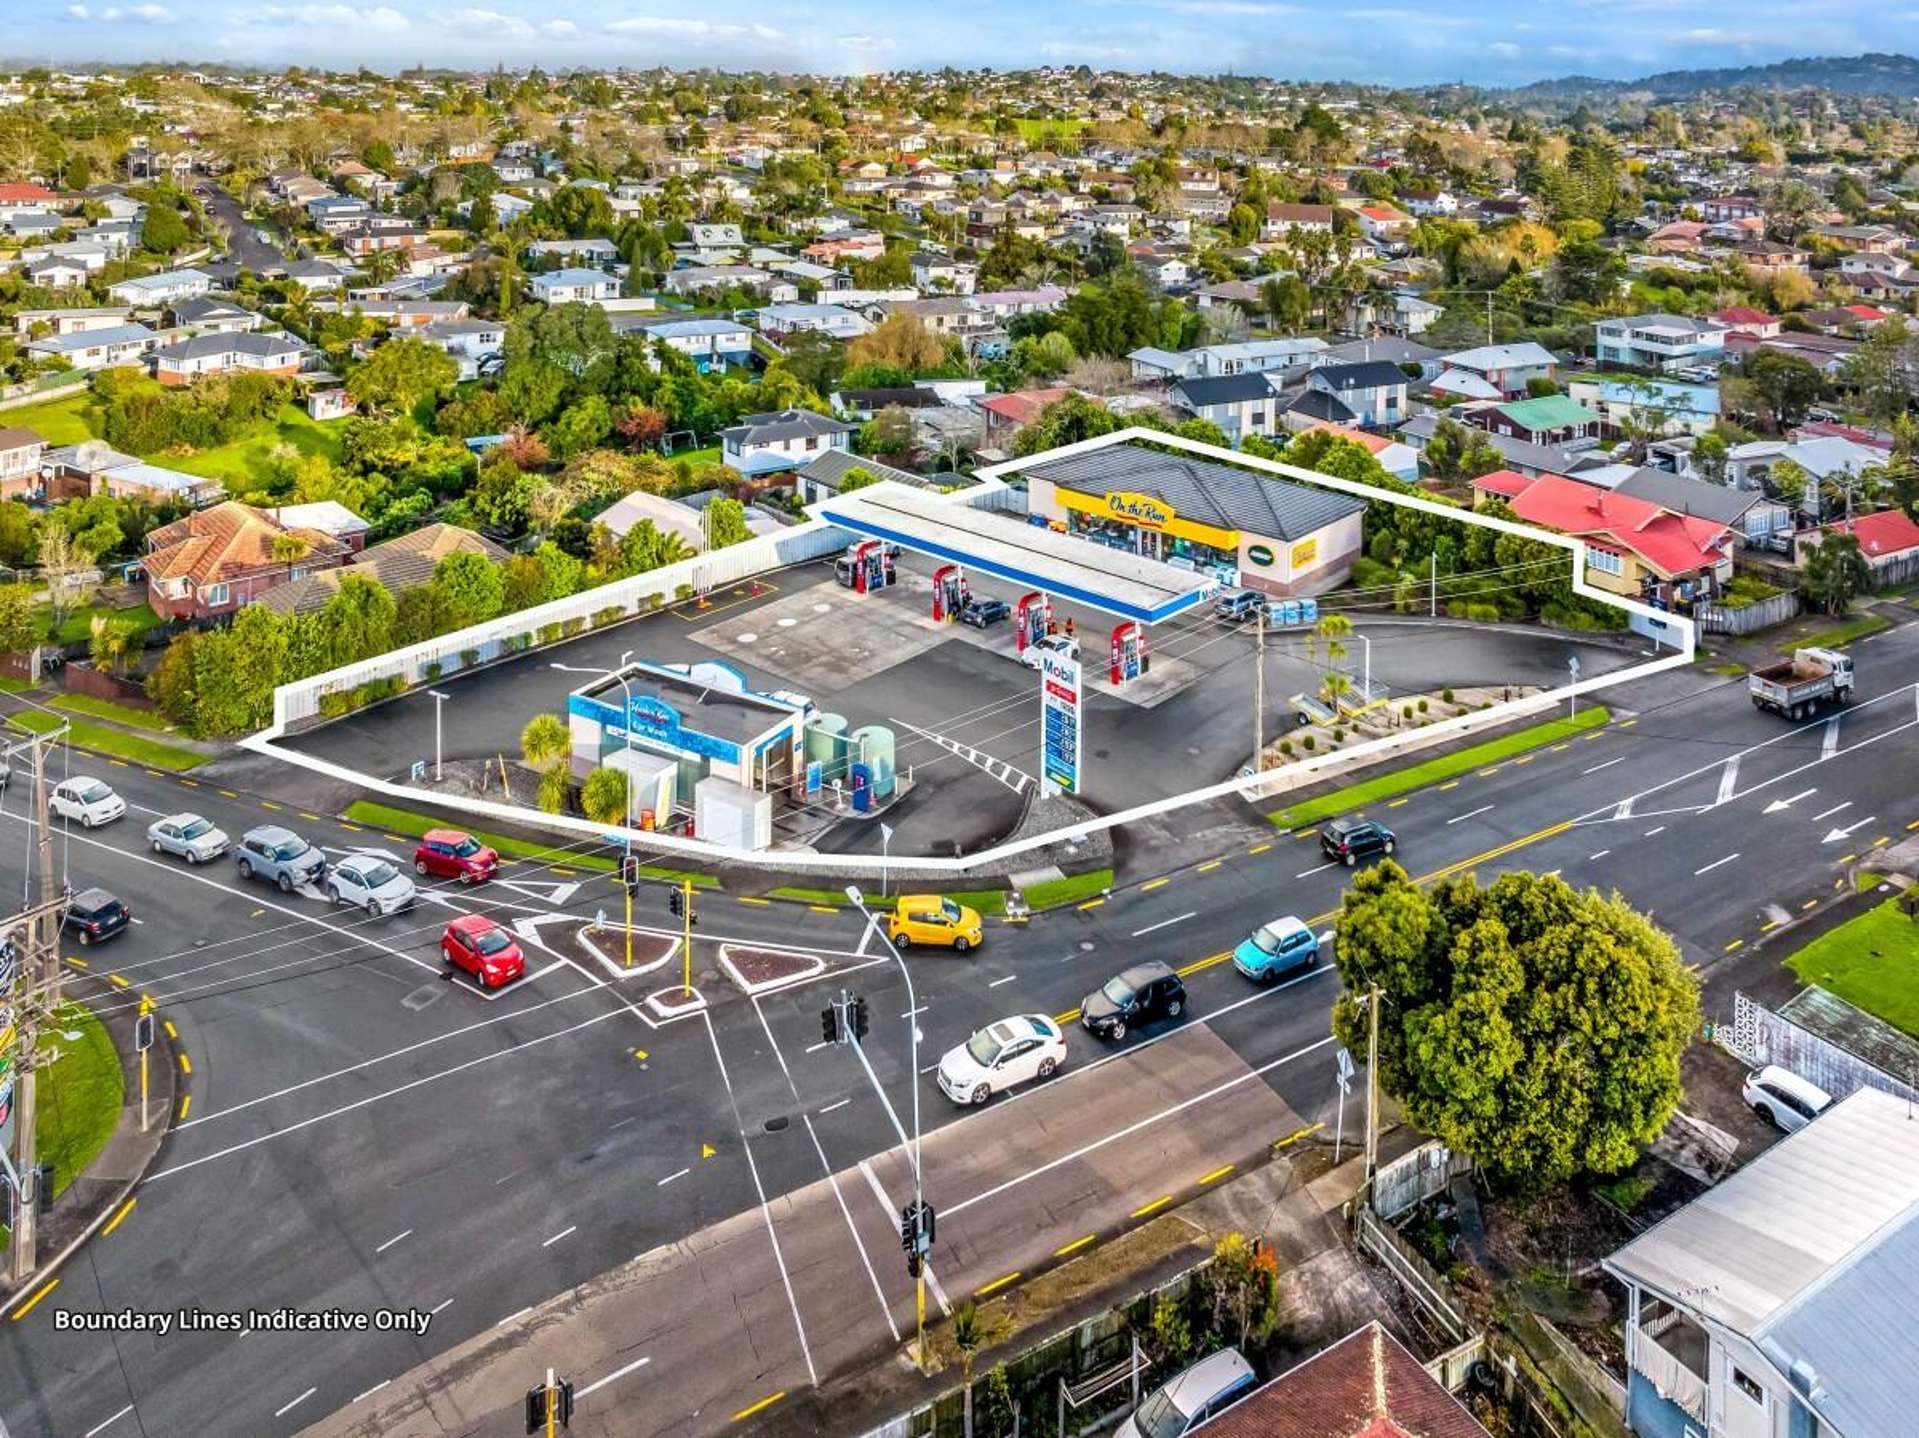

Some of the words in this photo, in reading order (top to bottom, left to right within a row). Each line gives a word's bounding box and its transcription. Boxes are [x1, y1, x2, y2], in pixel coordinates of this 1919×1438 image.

[1110, 495, 1125, 512] On
[1128, 500, 1143, 515] the
[1143, 503, 1168, 522] Run
[1043, 657, 1074, 685] Mobil
[632, 720, 645, 731] Car
[647, 724, 668, 740] Wash
